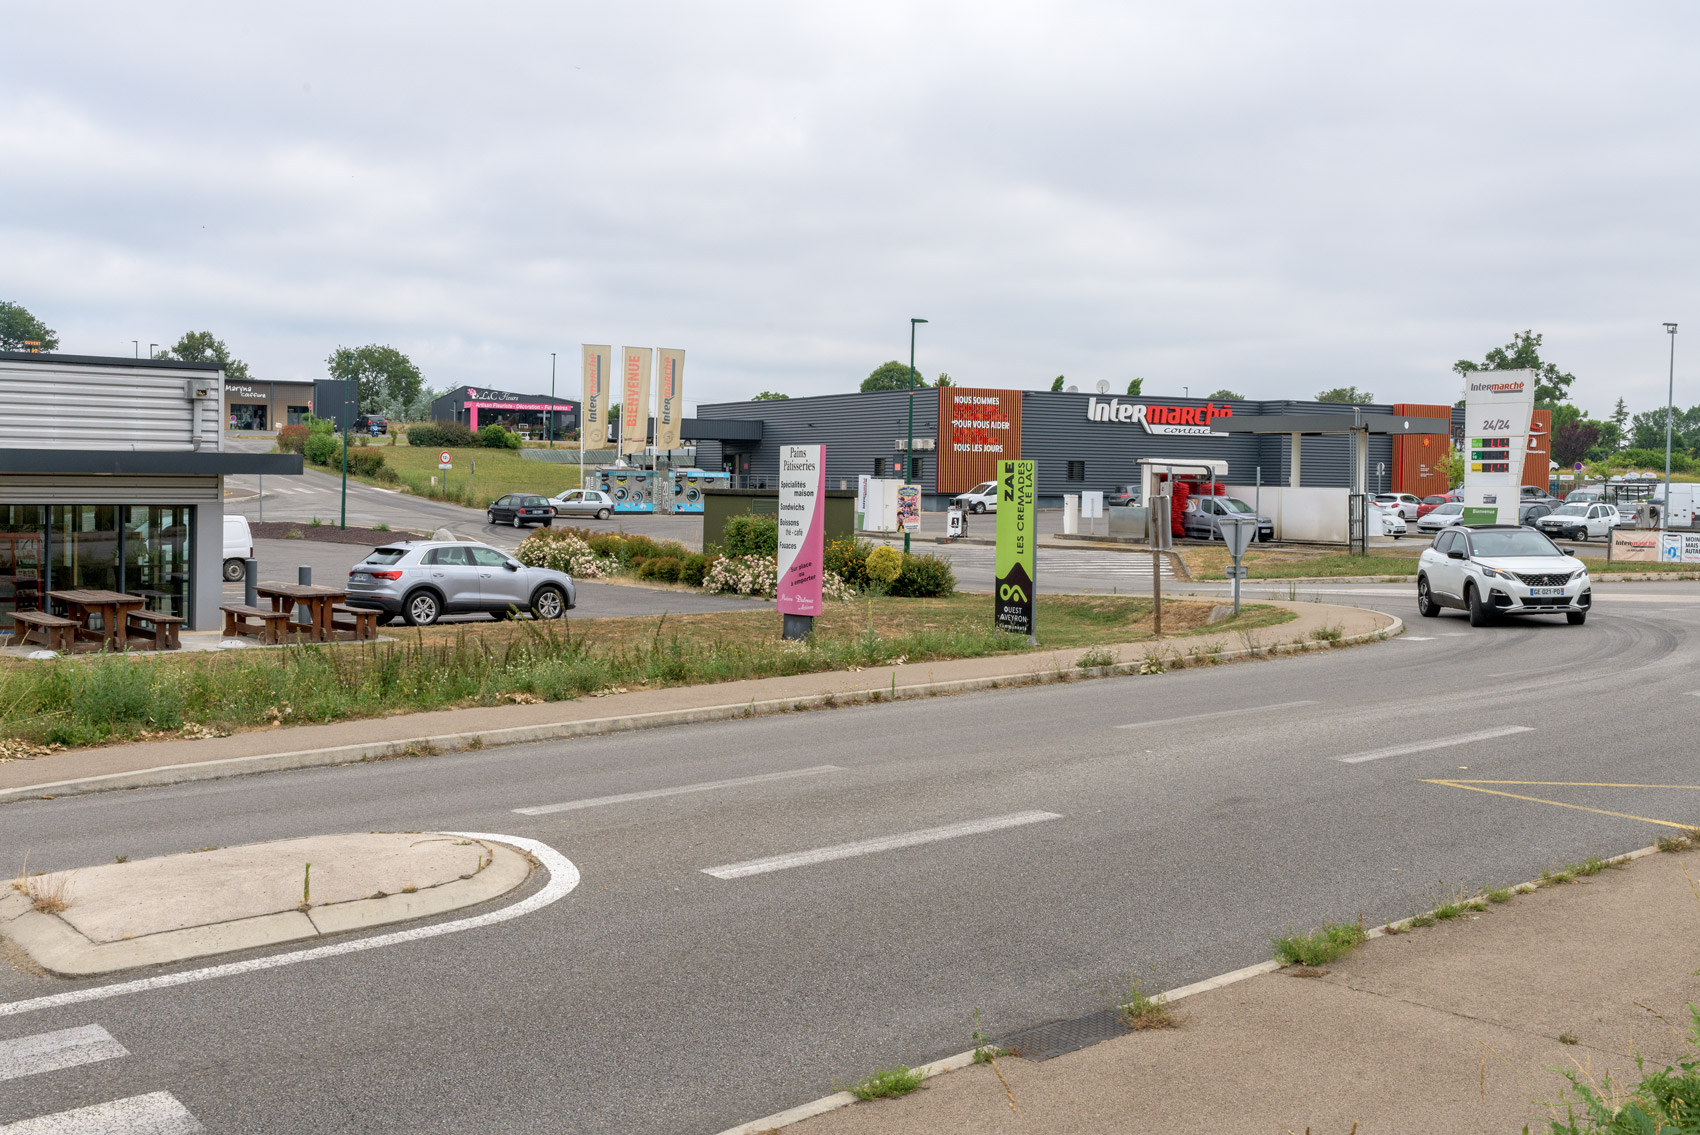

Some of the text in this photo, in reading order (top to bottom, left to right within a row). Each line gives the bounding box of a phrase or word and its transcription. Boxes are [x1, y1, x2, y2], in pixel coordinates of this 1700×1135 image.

[588, 353, 600, 422] Intermarché
[626, 355, 640, 426] BIENVENUE
[662, 356, 674, 424] Intermarché
[1471, 382, 1524, 394] Intermarché
[499, 392, 519, 401] Fleurs
[954, 396, 999, 405] NOUS SOMMES
[954, 404, 999, 413] PRODUCTEURS
[954, 420, 971, 428] POUR
[991, 421, 1010, 430] AIDER
[1482, 419, 1510, 431] 24/24
[960, 428, 987, 436] MANGER
[790, 447, 806, 458] Pains
[783, 460, 816, 471] Pâtisseries
[781, 481, 806, 490] Spécialités
[1004, 462, 1014, 502] ZAE
[1017, 462, 1025, 531] CREMADES
[1025, 492, 1032, 504] LE
[780, 503, 805, 511] Sandwichs
[780, 518, 799, 527] Boissons
[779, 541, 797, 550] Fouaces
[799, 562, 812, 570] place
[794, 574, 816, 585] emporter
[1004, 606, 1022, 614] OUEST
[1000, 614, 1027, 622] AVEYRON
